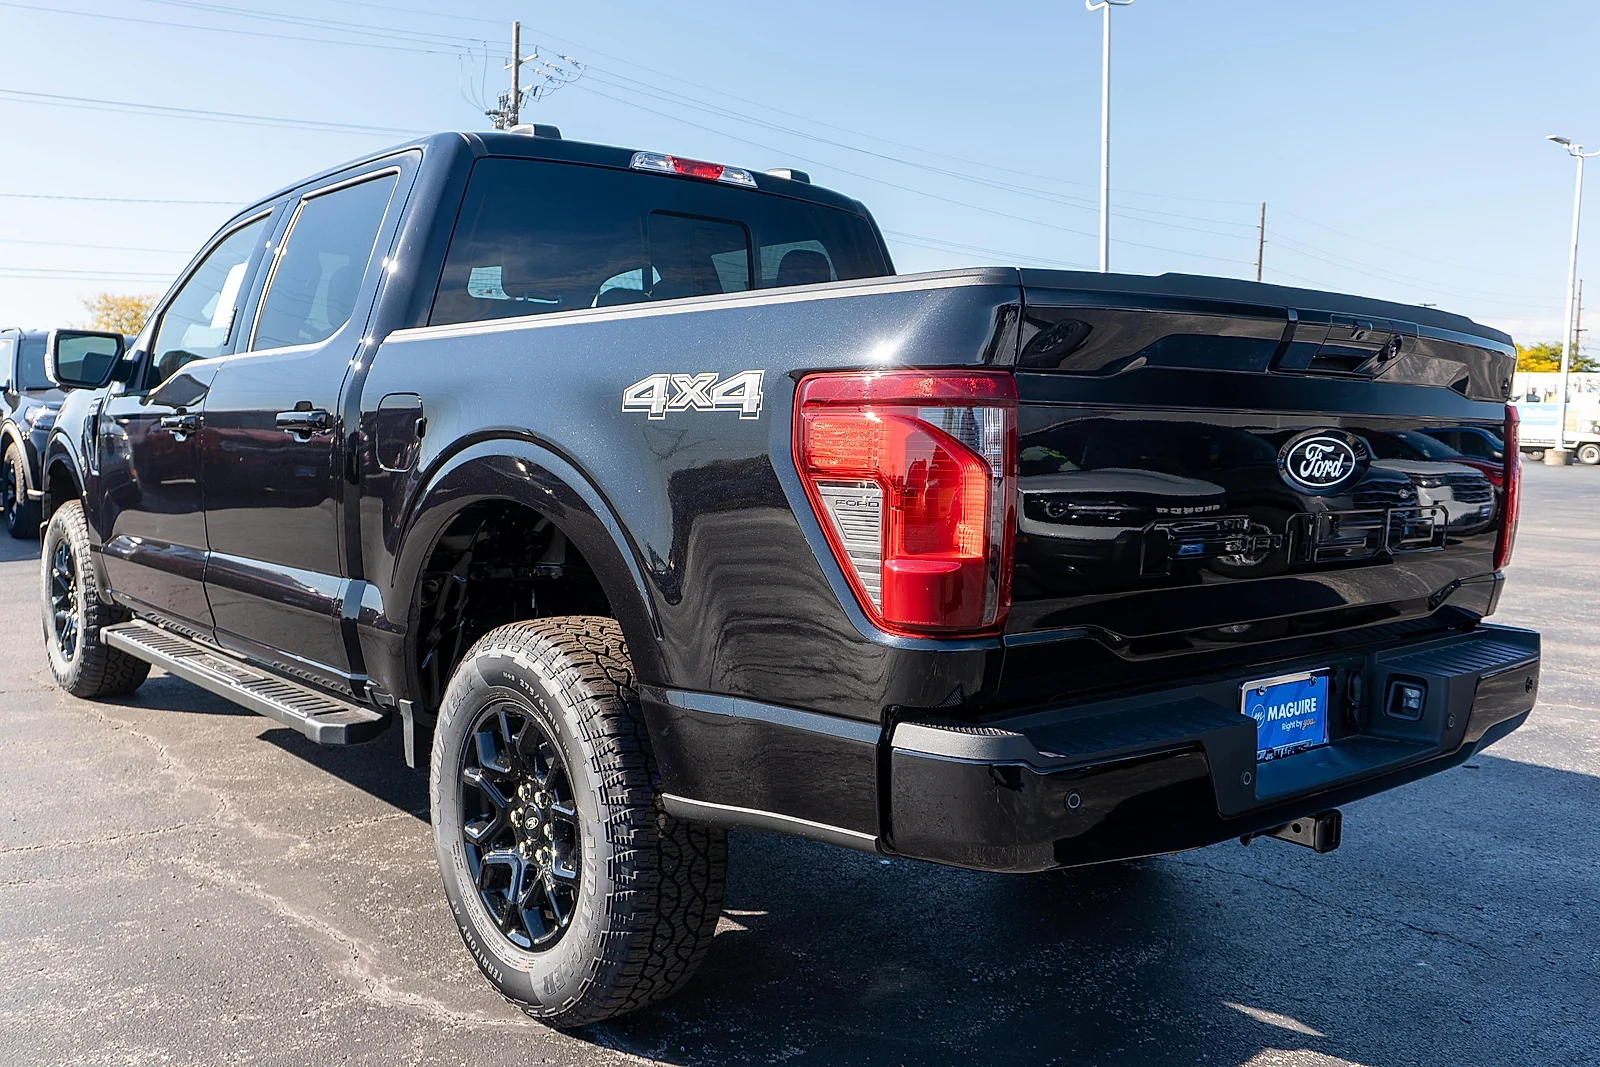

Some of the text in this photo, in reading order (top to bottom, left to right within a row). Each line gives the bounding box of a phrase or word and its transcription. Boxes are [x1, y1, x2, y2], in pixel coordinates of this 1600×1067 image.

[1300, 443, 1345, 478] Ford
[835, 499, 880, 508] FORD
[1267, 697, 1317, 722] MAGUIRE
[1281, 721, 1296, 732] Right
[1296, 719, 1303, 728] by
[461, 925, 504, 984] TERRITORY
